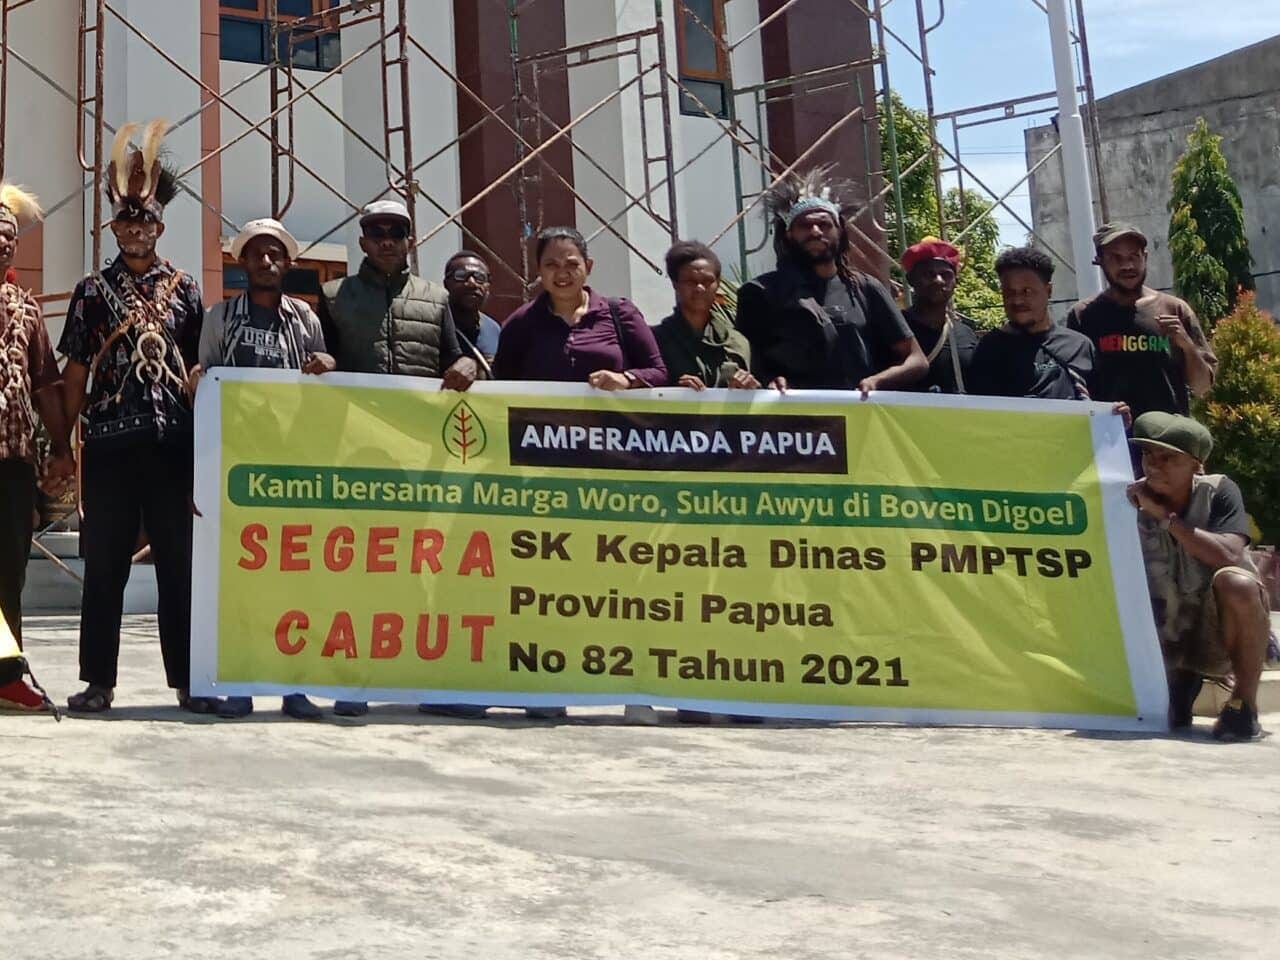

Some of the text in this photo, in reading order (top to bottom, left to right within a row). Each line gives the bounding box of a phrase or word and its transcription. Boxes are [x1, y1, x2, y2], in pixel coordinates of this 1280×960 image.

[520, 424, 836, 456] AMPERAMADA PAPUA
[248, 472, 1074, 531] Kami bersama Marga Woro, Suku Awyu di Boven Digoel
[237, 522, 495, 579] SEGERA
[510, 529, 1092, 579] SK Kepala Dinas PMPTSP
[509, 585, 834, 633] Provinsi Papua
[274, 609, 495, 663] CABUT
[508, 642, 910, 688] No 82 Tahun 2021
